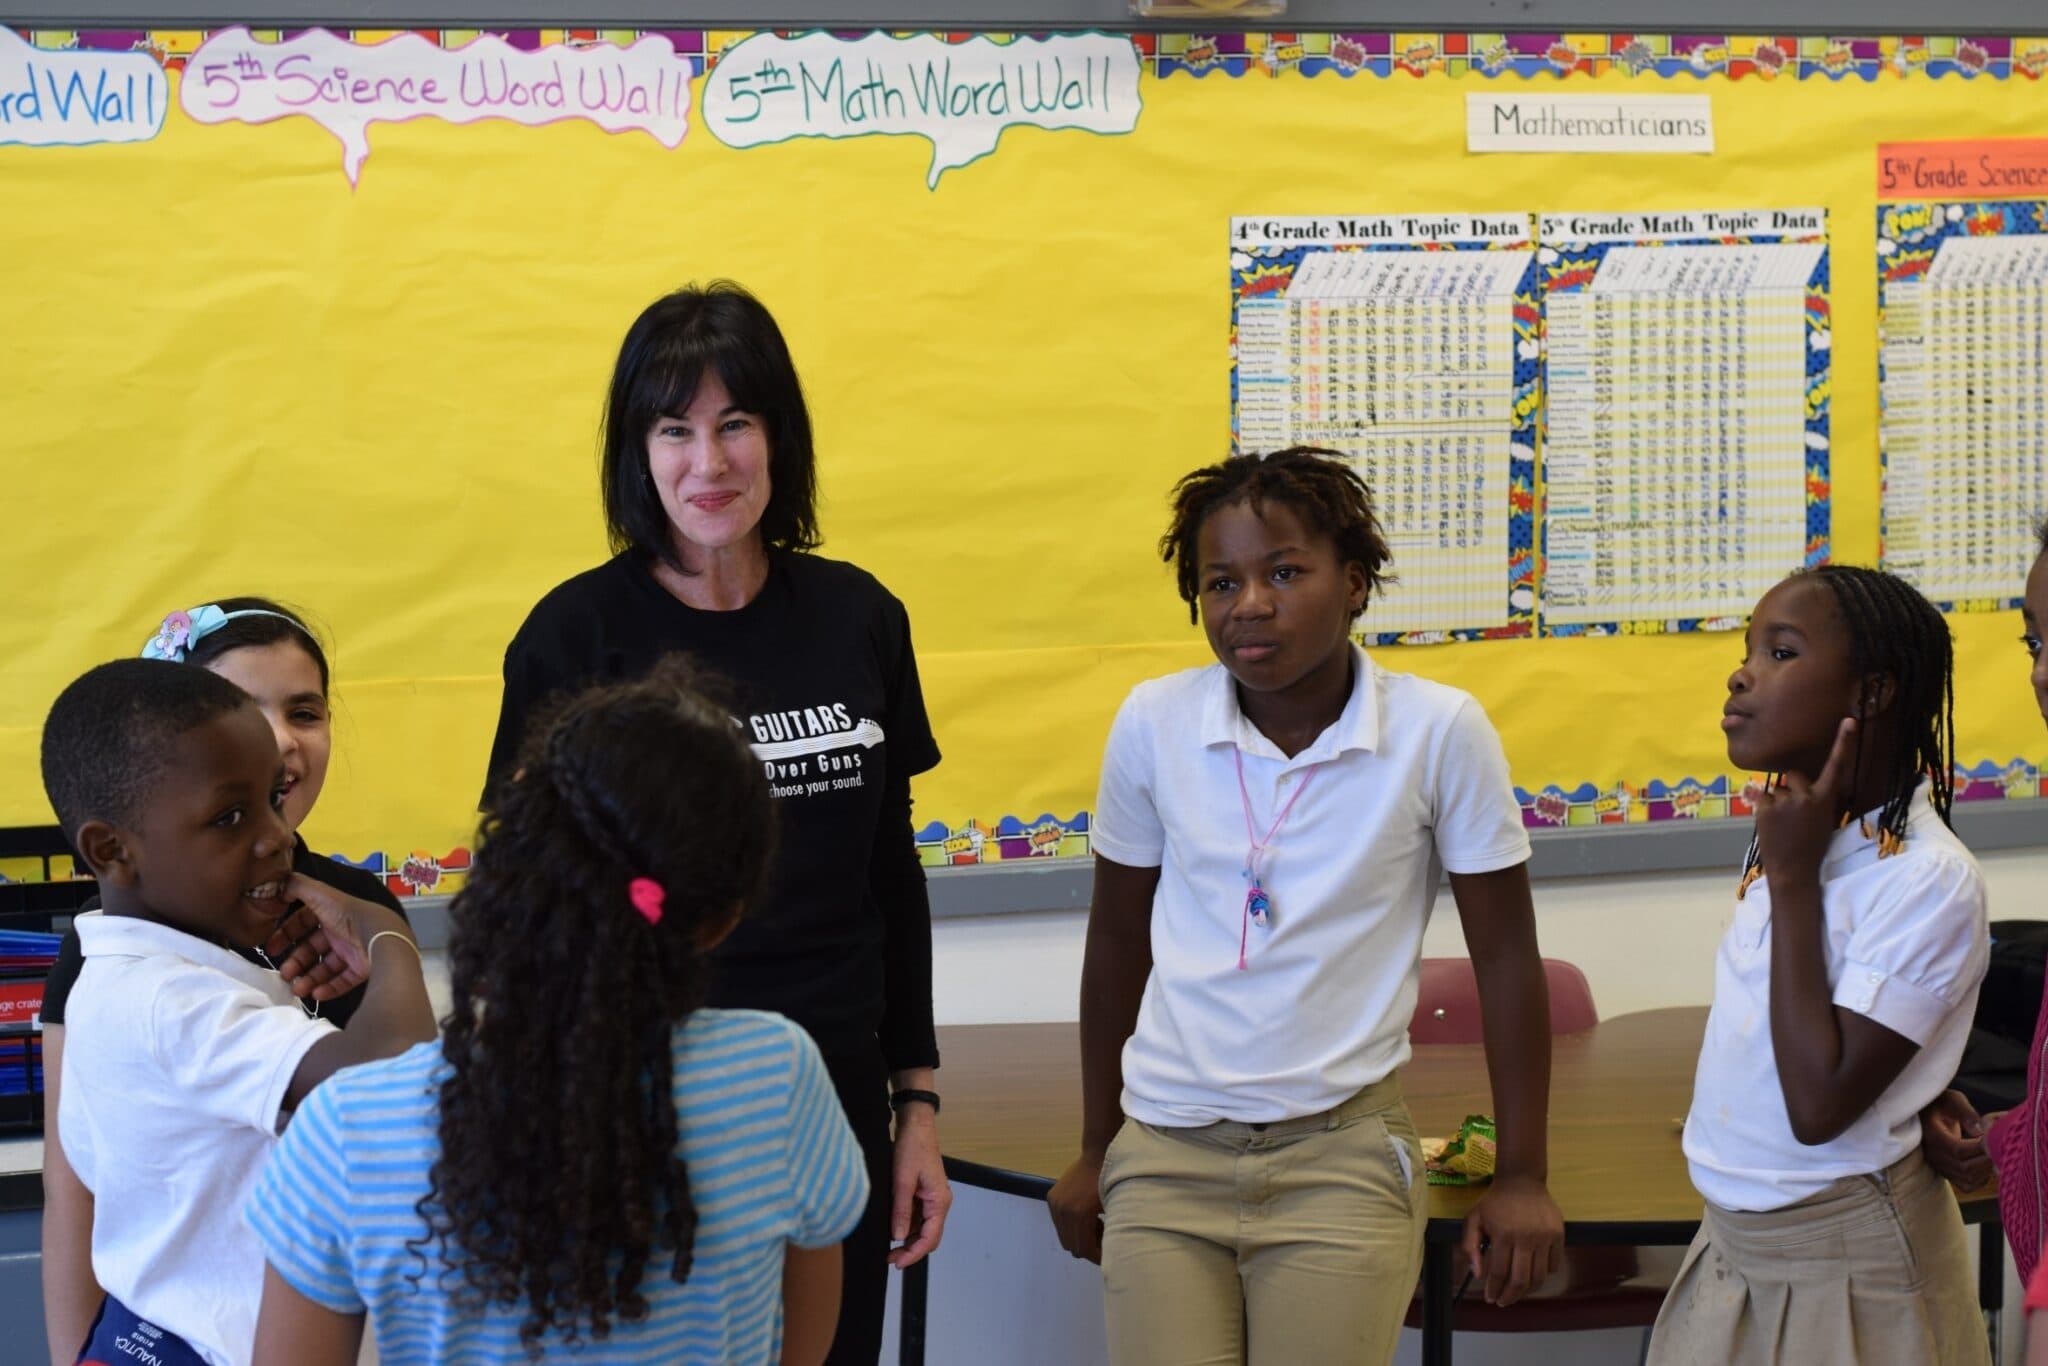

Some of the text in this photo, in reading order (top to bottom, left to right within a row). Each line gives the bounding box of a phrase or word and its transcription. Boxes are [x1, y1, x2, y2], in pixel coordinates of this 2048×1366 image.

[0, 61, 153, 126] rd Wall
[201, 51, 682, 118] 5th Science Word Wall
[725, 56, 1110, 124] 5th Math Word Wall
[1492, 103, 1706, 138] Mathematicians
[1883, 157, 1912, 190] 5th
[1914, 157, 1968, 189] Grade
[1234, 217, 1519, 240] 4th Grade Math Topic Data
[1542, 211, 1817, 236] 5th Grade Math Topic Data
[750, 702, 853, 743] GUITARS
[764, 753, 862, 780] Over Guns
[806, 780, 829, 797] your
[832, 771, 864, 790] sound.
[115, 1336, 162, 1366] NAUTICA
